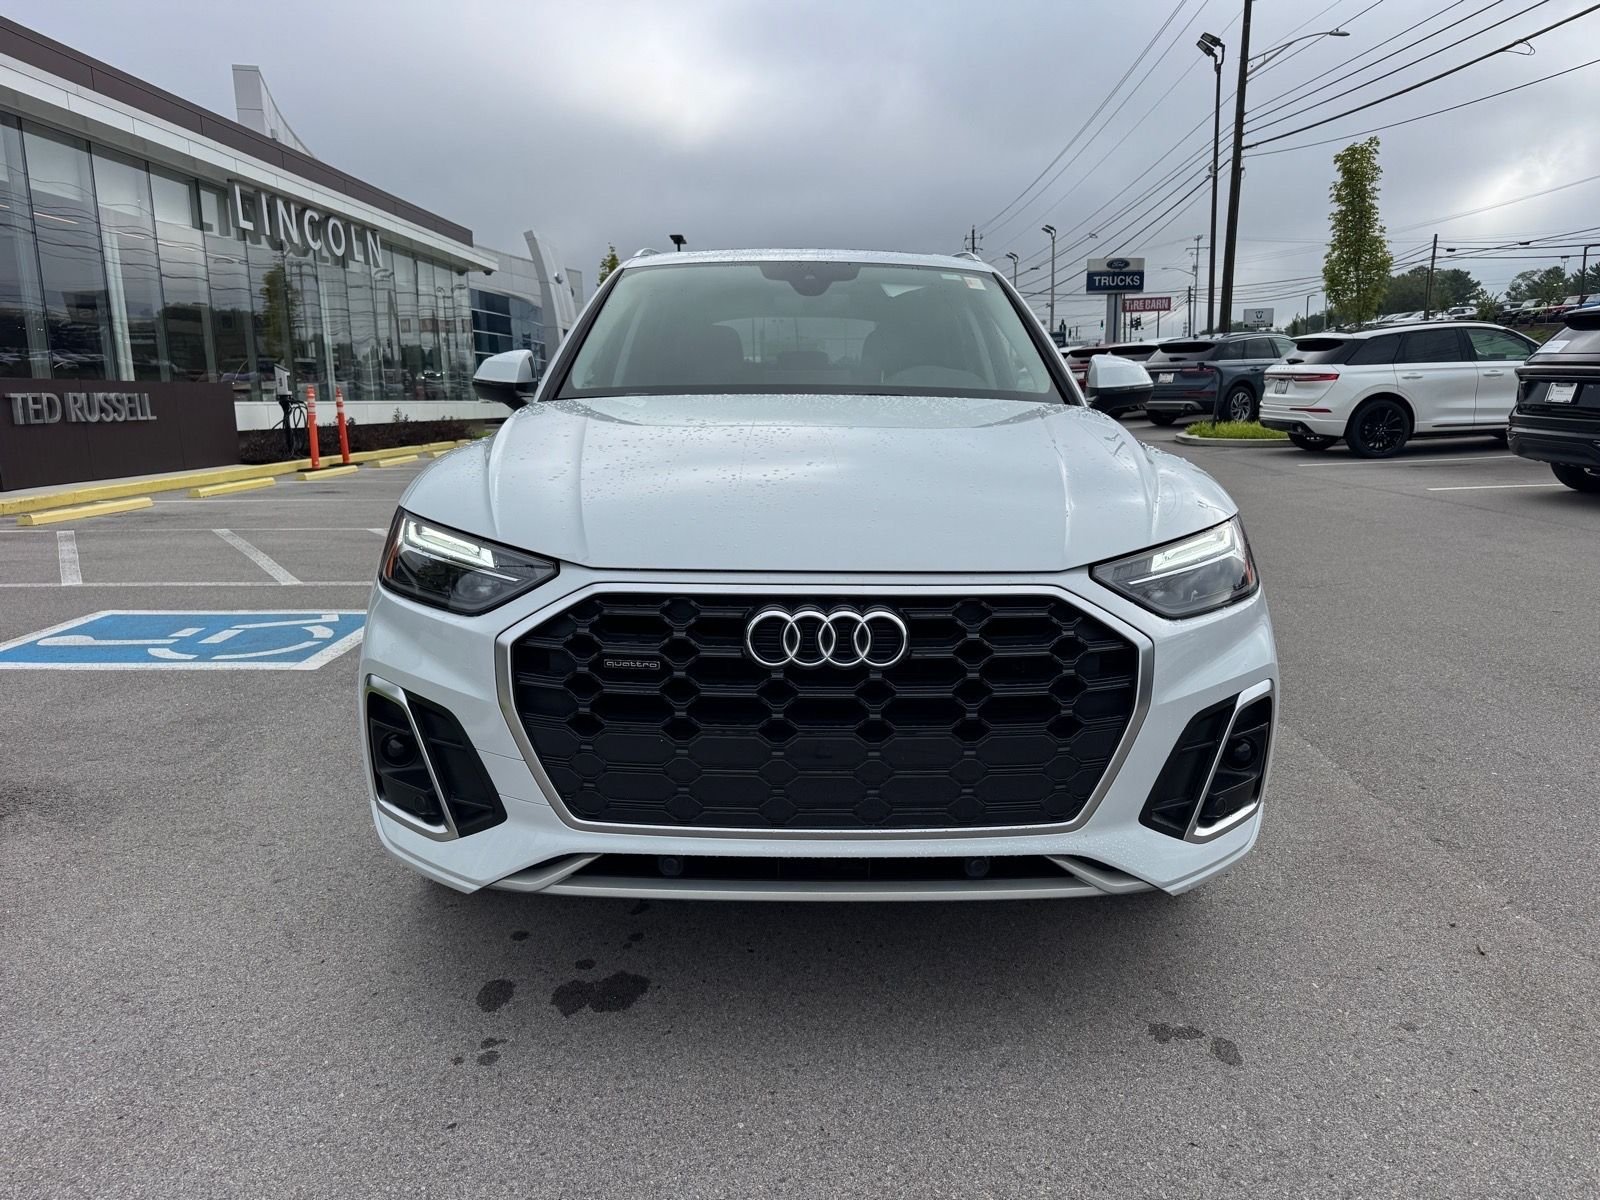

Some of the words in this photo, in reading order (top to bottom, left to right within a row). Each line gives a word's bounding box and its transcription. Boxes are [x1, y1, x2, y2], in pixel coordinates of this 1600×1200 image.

[231, 181, 383, 268] LINCOLN
[1093, 275, 1140, 287] TRUCKS
[1145, 298, 1169, 310] BARN
[6, 392, 62, 424] TED
[64, 392, 157, 422] RUSSELL
[606, 661, 657, 669] quattro
